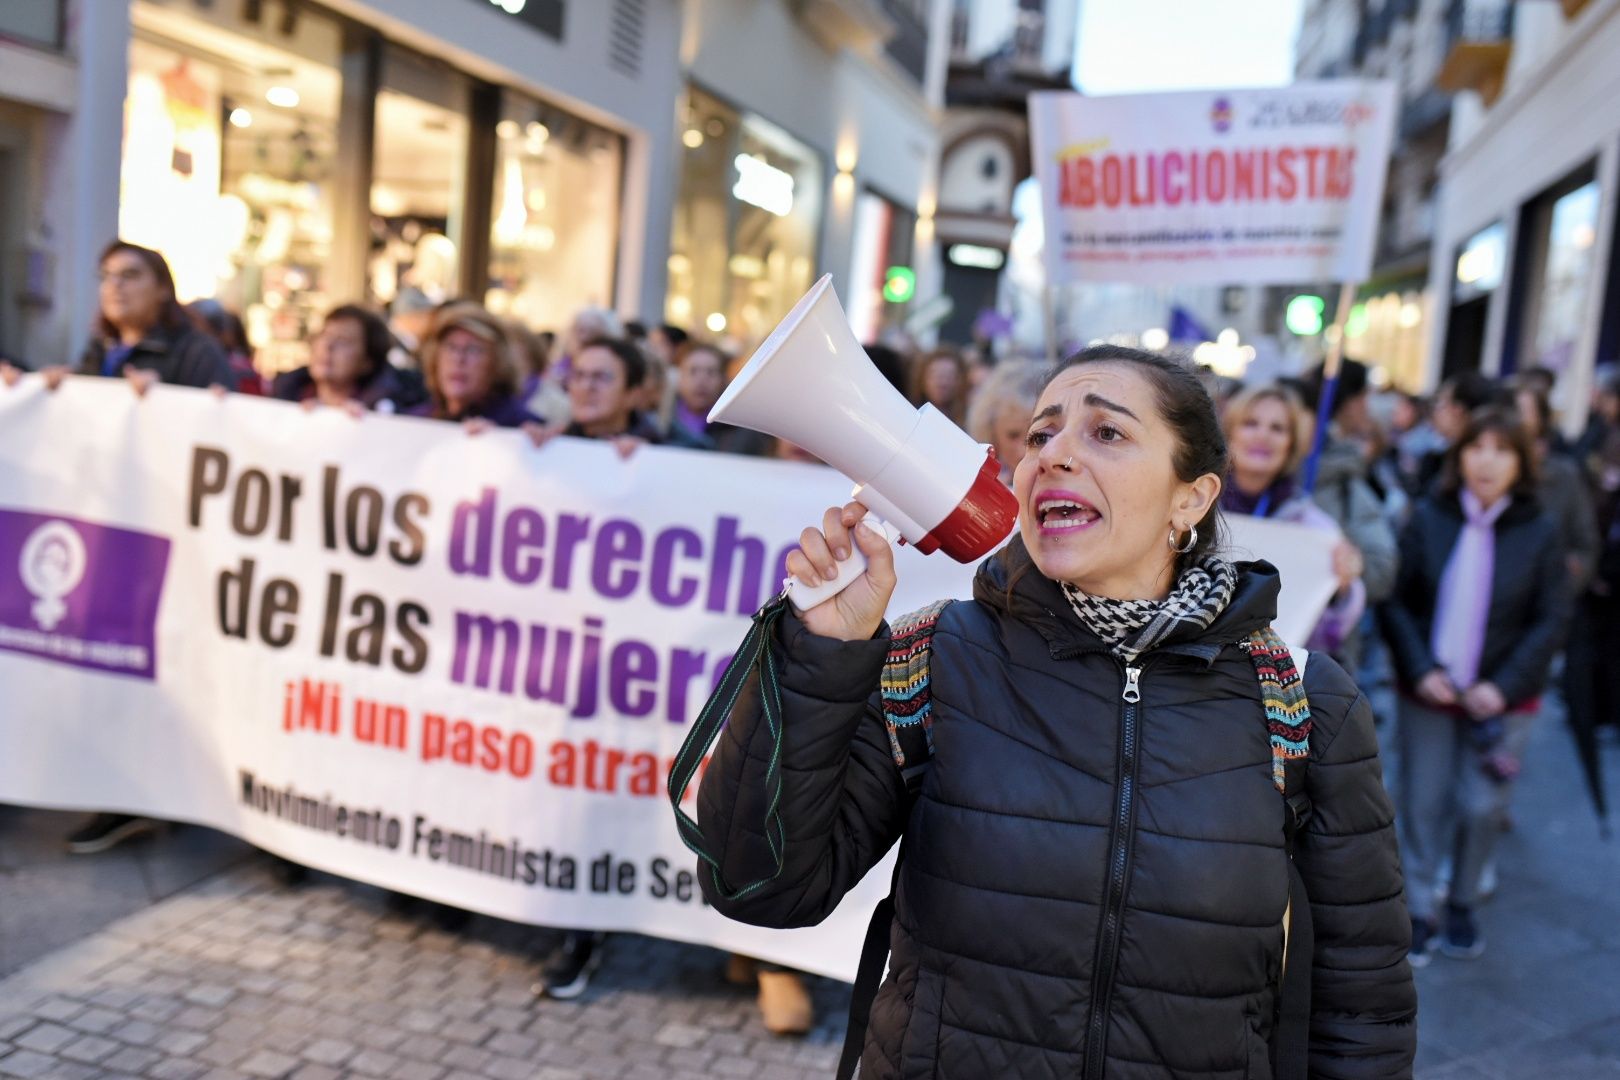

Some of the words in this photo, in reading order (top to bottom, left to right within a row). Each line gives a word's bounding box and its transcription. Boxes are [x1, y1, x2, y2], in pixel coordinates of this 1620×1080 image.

[1059, 147, 1355, 208] ABOLICIONISTAS
[189, 446, 300, 542] Por
[323, 464, 430, 566] los
[217, 558, 299, 648] de
[320, 572, 429, 674] las
[450, 610, 741, 723] mujer
[283, 679, 341, 735] ¡Ni
[354, 698, 407, 751] un
[421, 713, 533, 778] paso
[239, 769, 401, 850] Movimiento
[412, 815, 577, 891] Feminista
[591, 852, 637, 895] de
